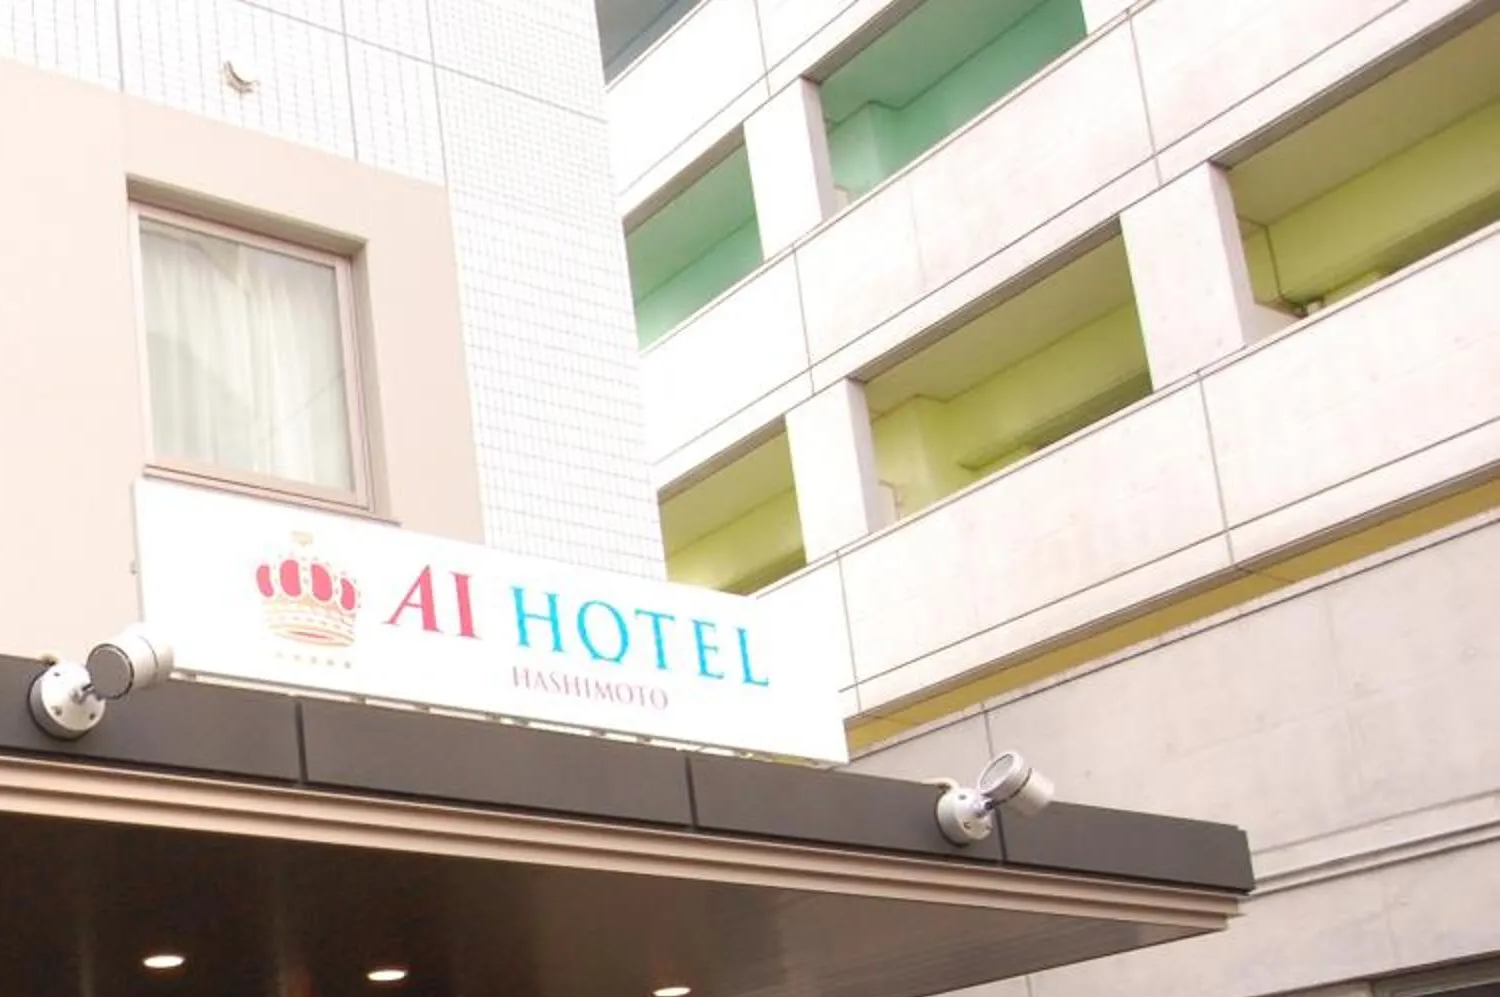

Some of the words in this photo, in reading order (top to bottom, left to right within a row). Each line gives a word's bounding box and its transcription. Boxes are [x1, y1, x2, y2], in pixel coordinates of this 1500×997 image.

[381, 564, 483, 641] AI
[510, 585, 770, 687] HOTEL
[511, 666, 669, 710] HASHIMOTO
